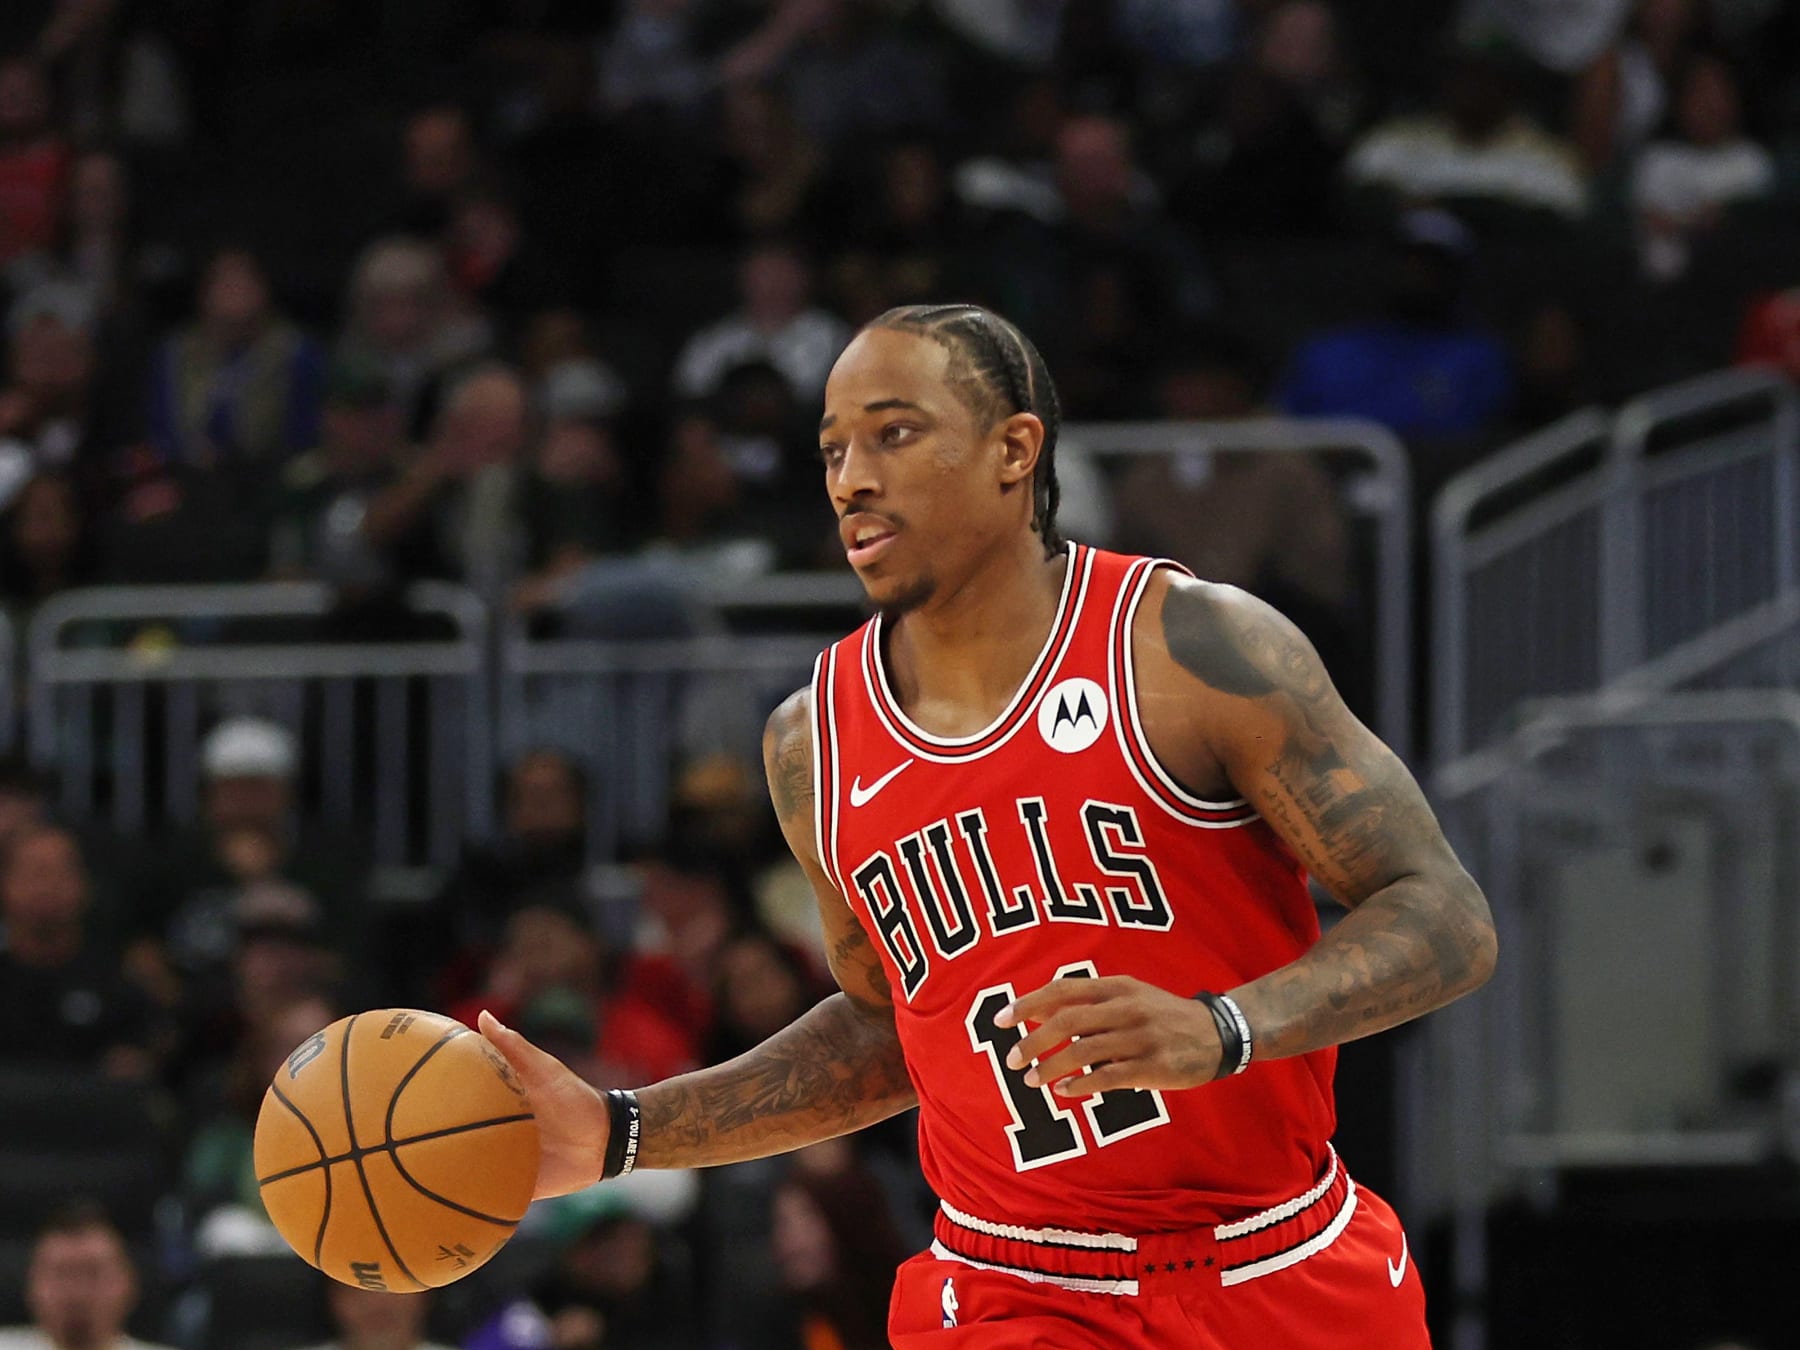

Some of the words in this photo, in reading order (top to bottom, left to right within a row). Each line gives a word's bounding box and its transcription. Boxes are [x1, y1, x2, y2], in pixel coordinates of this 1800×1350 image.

[851, 796, 1175, 1004] BULLS
[629, 1119, 639, 1137] YOU
[626, 1138, 638, 1154] ARE
